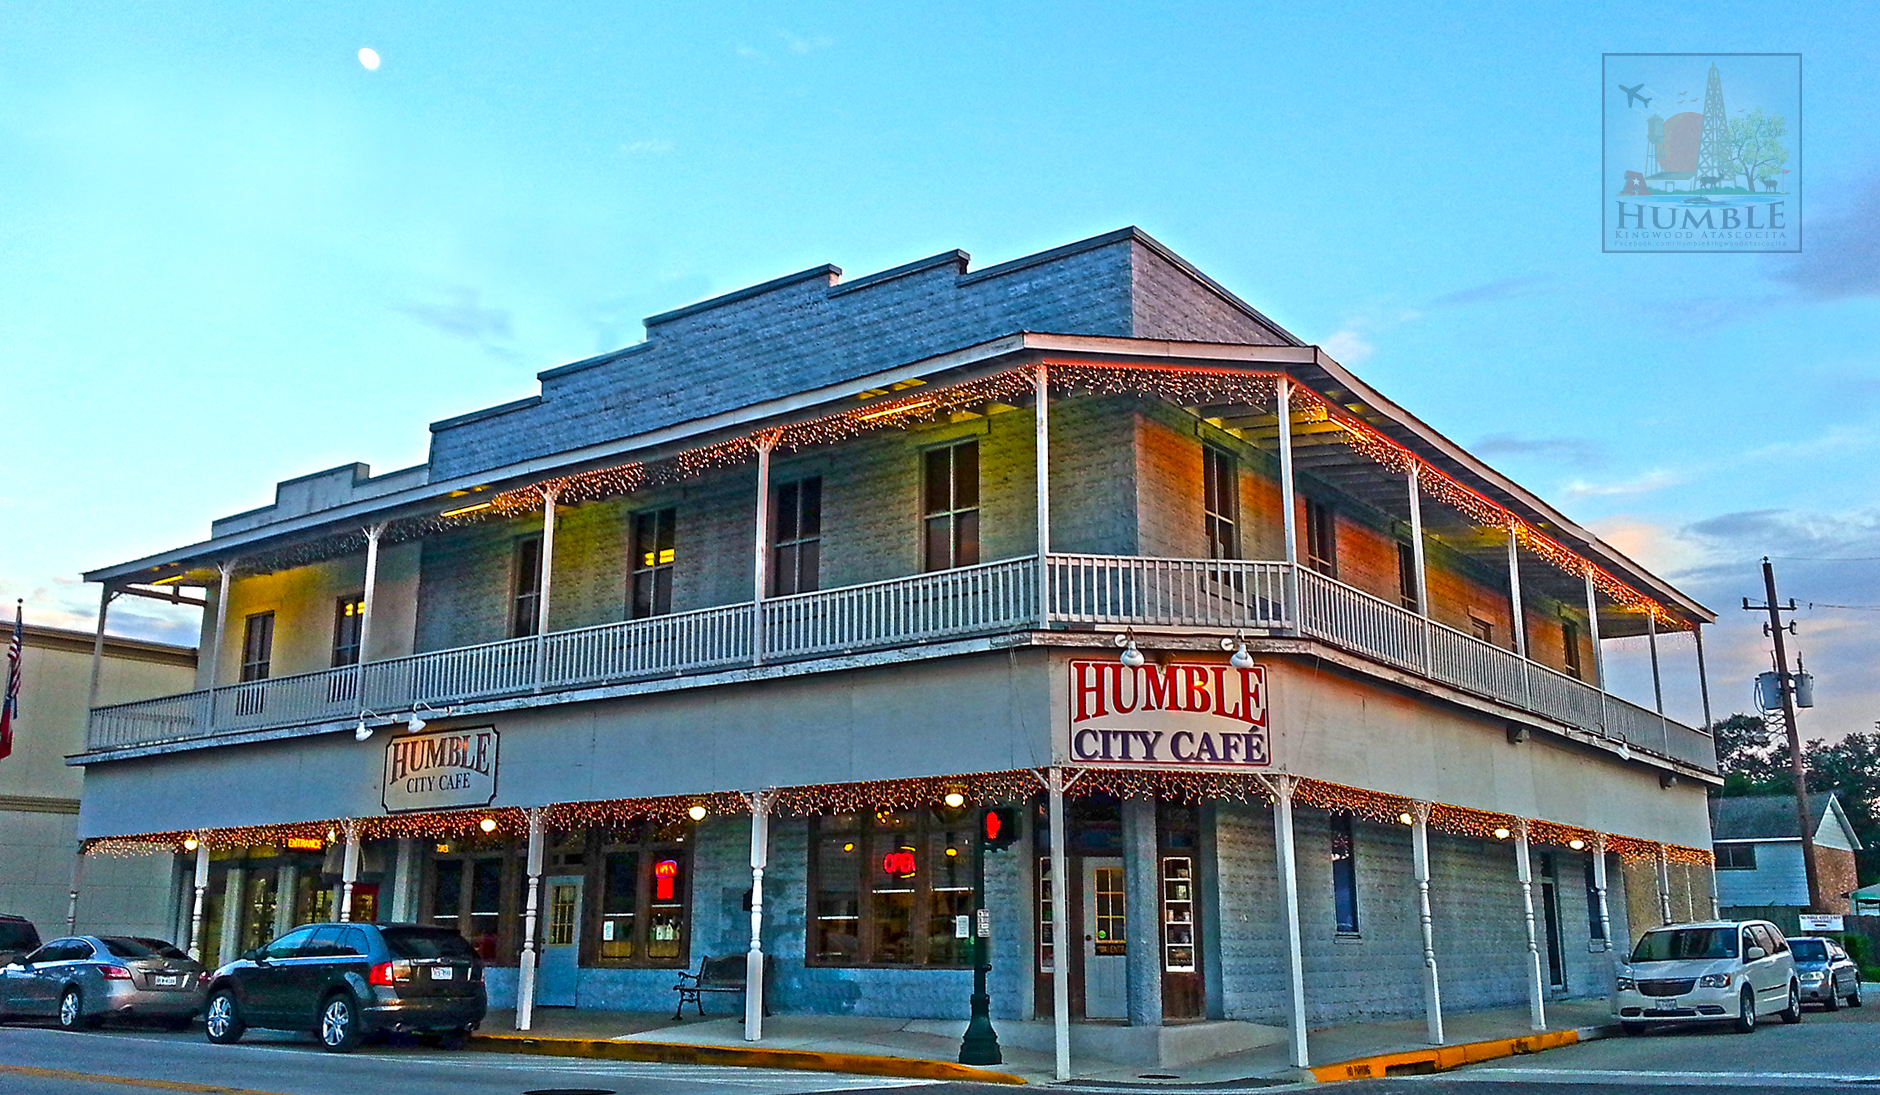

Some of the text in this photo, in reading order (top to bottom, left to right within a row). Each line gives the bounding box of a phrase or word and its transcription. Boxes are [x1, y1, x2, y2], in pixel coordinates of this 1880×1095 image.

[1073, 662, 1266, 727] HUMBLE
[390, 733, 491, 785] HUMBLE
[1074, 725, 1266, 762] CITY CAFÉ
[406, 773, 471, 793] CITY CAFE
[288, 838, 322, 849] ENTRANCE
